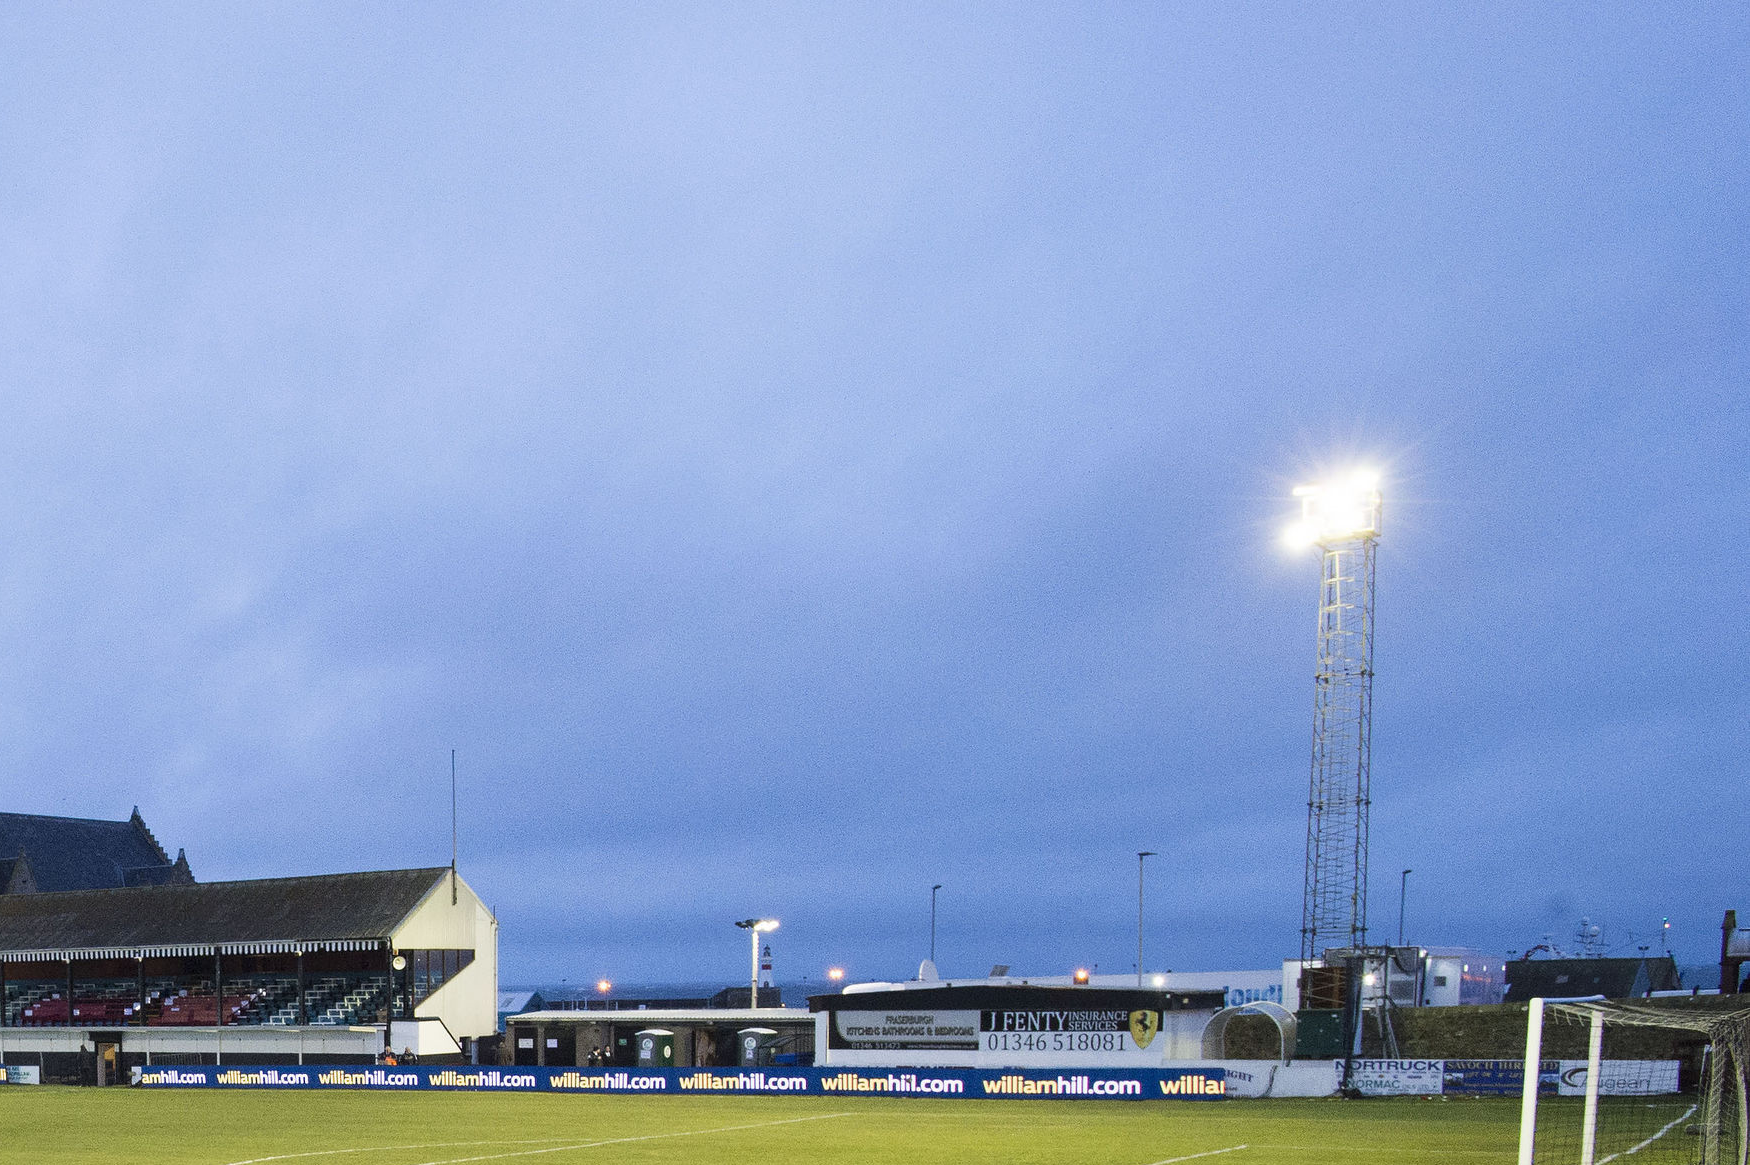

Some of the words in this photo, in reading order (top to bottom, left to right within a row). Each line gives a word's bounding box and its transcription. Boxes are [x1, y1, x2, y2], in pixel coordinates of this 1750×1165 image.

[885, 1015, 934, 1025] FRASERBURGH
[989, 1011, 996, 1031] J
[1003, 1011, 1068, 1031] FENTY
[1068, 1010, 1128, 1021] INSURANCE
[846, 1026, 880, 1036] KITCHENS
[882, 1026, 925, 1036] BATHROOMS
[927, 1027, 934, 1036] &
[934, 1026, 975, 1036] BEDROOMS
[1068, 1020, 1118, 1031] SERVICES
[987, 1033, 1047, 1051] 01346
[1053, 1033, 1126, 1051] 518081
[1447, 1061, 1494, 1070] SAVOCH
[1498, 1061, 1525, 1070] HIR
[141, 1070, 206, 1084] amhill.com
[216, 1070, 309, 1084] williamhill.com
[318, 1070, 418, 1086] williamhill.com
[429, 1071, 536, 1087] williamhill.com
[549, 1072, 666, 1090] williamhill.com
[679, 1072, 807, 1090] williamhill.com
[821, 1073, 964, 1093] williamhill.com
[1347, 1079, 1401, 1089] NORMAC
[983, 1075, 1142, 1095] williamhill.com
